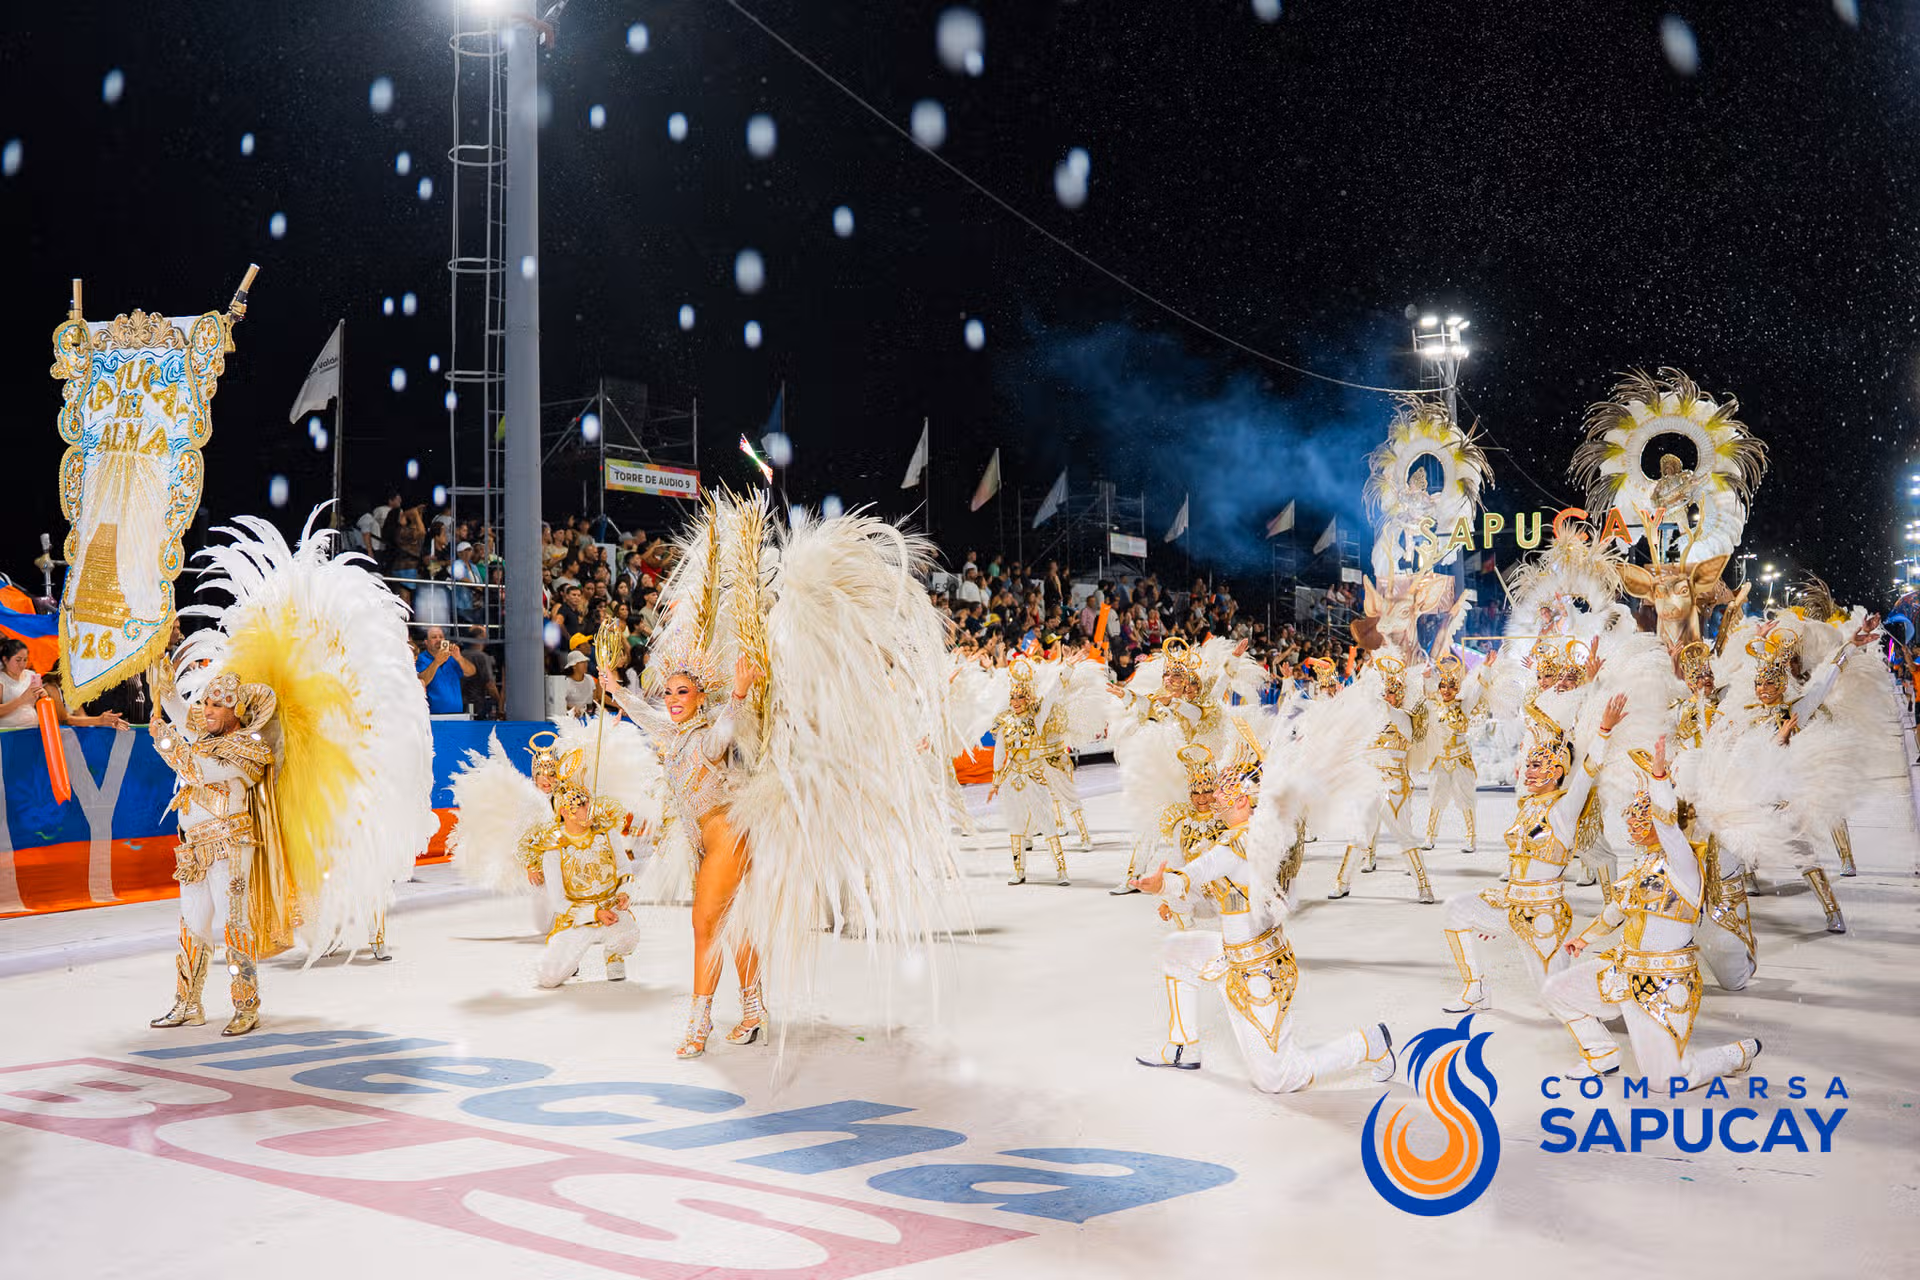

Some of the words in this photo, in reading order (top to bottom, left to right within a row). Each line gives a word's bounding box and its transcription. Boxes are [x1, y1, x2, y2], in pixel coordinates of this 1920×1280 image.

[95, 423, 170, 456] ALMA
[614, 471, 643, 483] TORRE
[645, 474, 656, 484] DE
[658, 476, 684, 488] AUDIO
[685, 481, 690, 489] 9
[1419, 507, 1667, 551] SAPUCAY
[128, 1030, 1238, 1223] flecha
[0, 1063, 902, 1270] BUS
